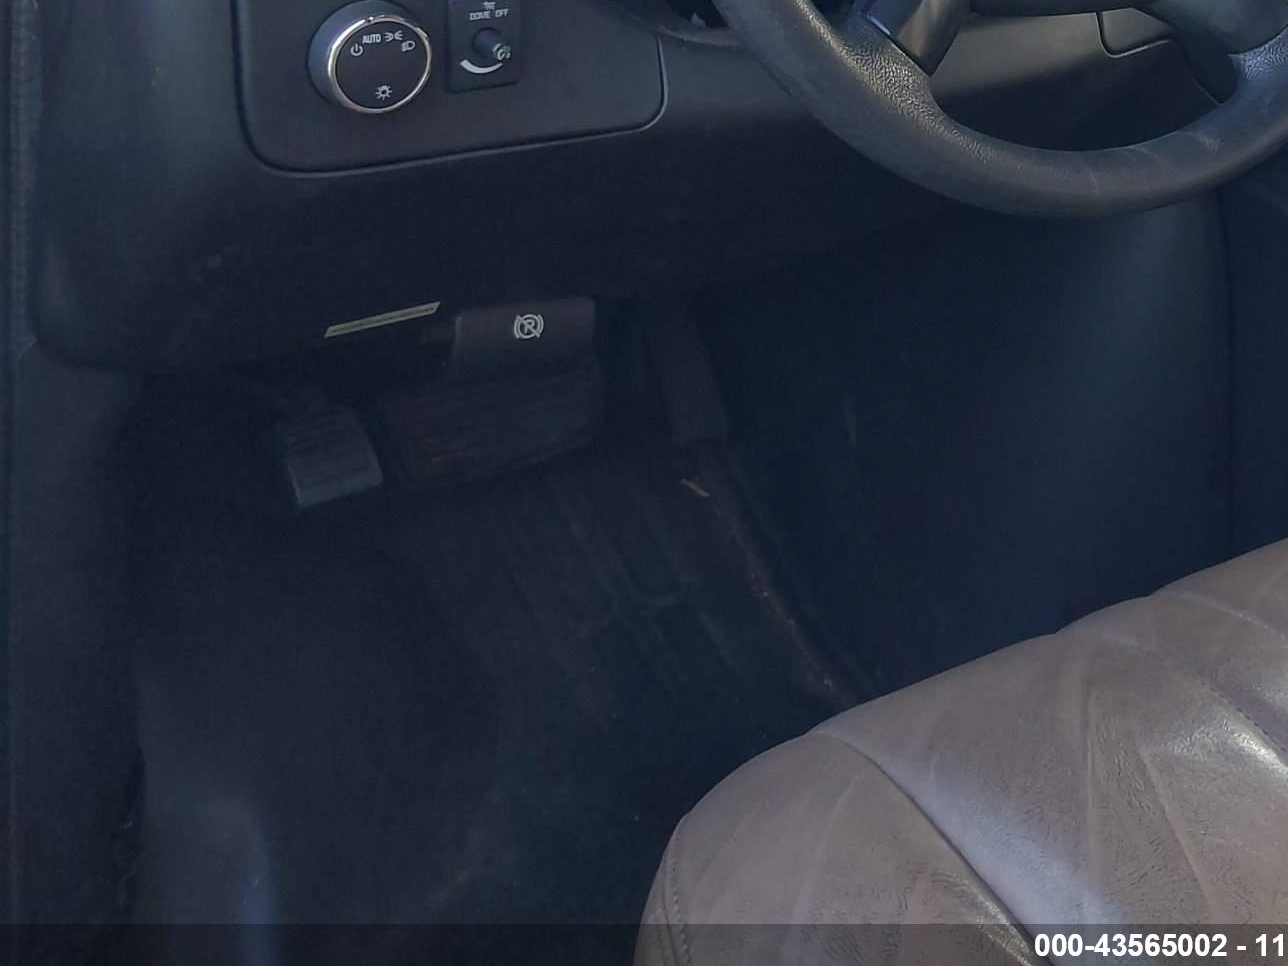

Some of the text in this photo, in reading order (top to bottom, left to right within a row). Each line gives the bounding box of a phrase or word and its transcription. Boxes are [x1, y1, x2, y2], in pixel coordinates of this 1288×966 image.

[469, 8, 509, 21] DOME OFF
[362, 33, 382, 45] AUTO
